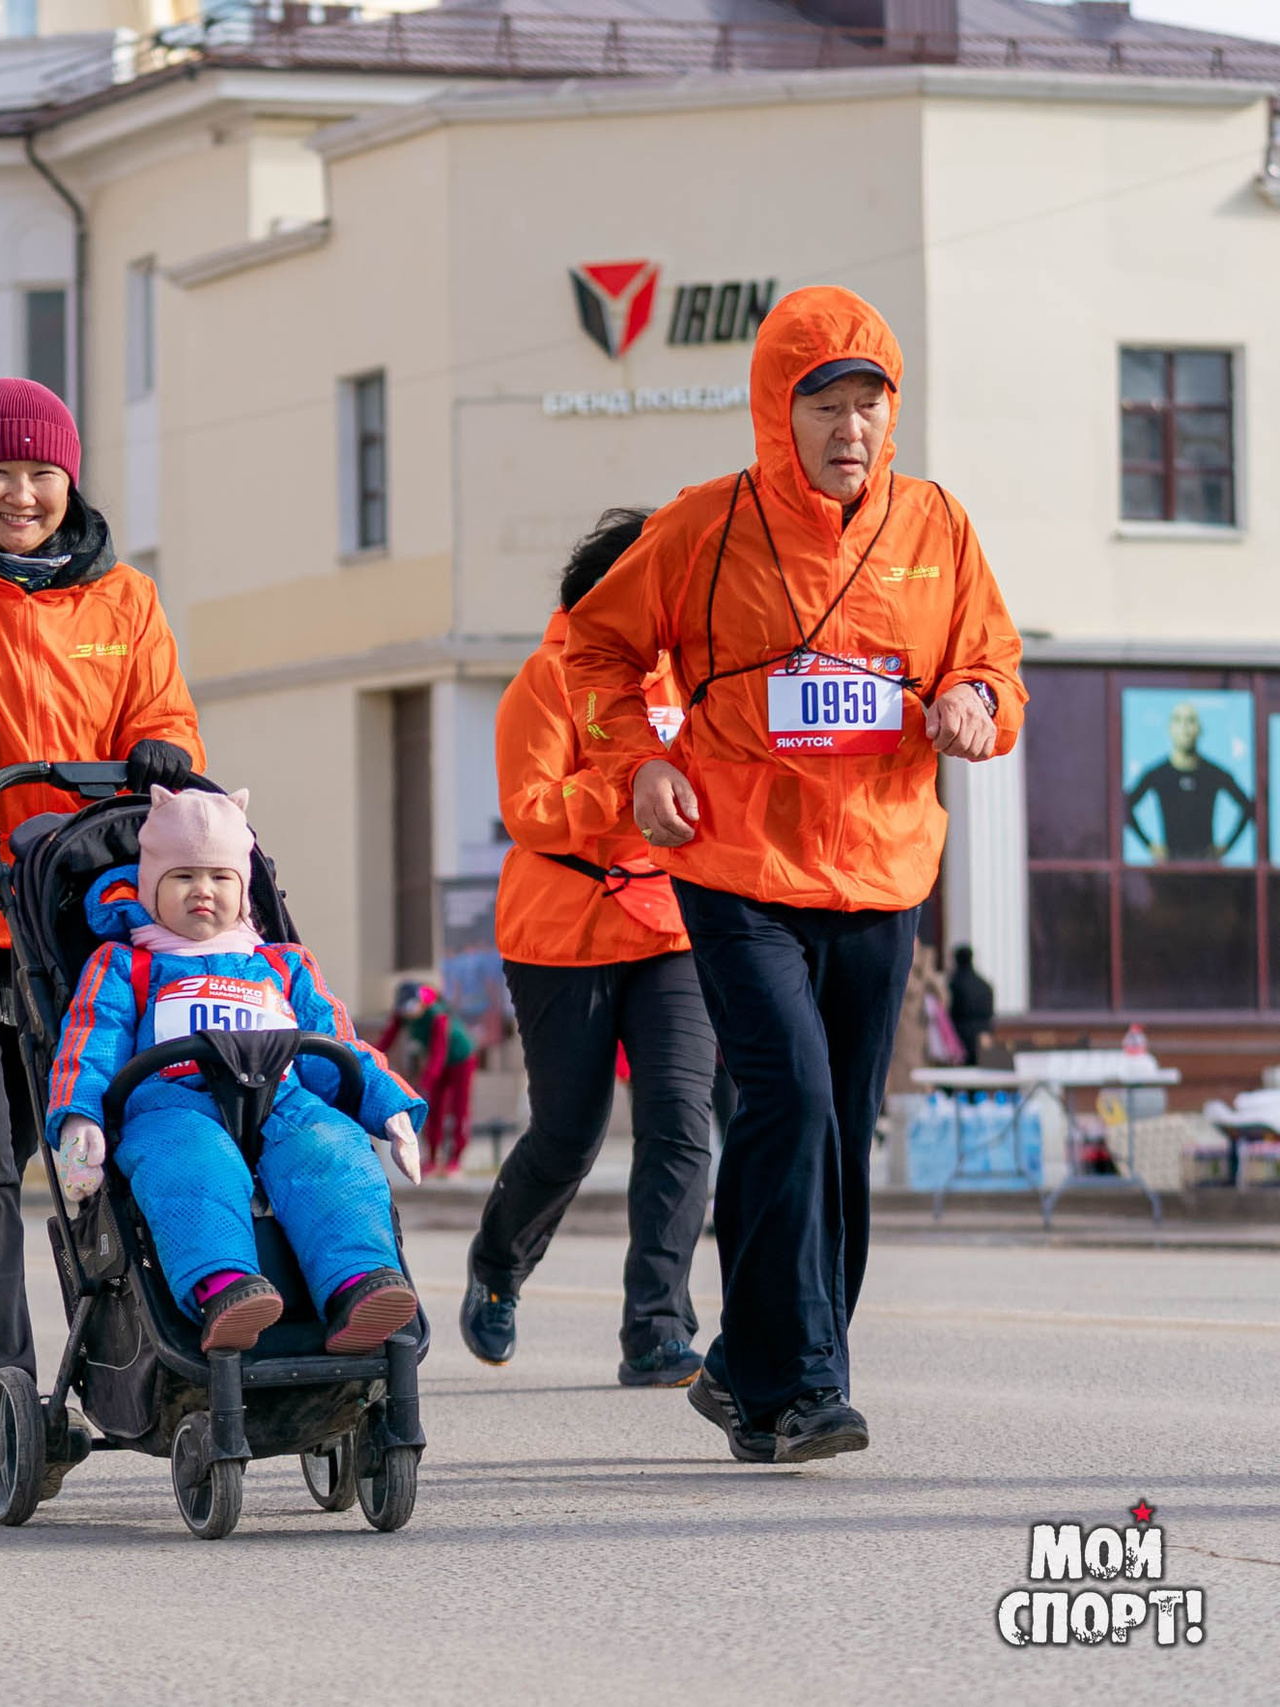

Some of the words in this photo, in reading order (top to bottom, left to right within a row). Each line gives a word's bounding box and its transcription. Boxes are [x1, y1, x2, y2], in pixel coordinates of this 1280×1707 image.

[667, 278, 779, 346] IRON
[801, 681, 877, 725] 0959
[775, 736, 834, 749] ЯКУТСК
[208, 983, 263, 997] ОЛОНХО
[190, 1003, 265, 1034] 059
